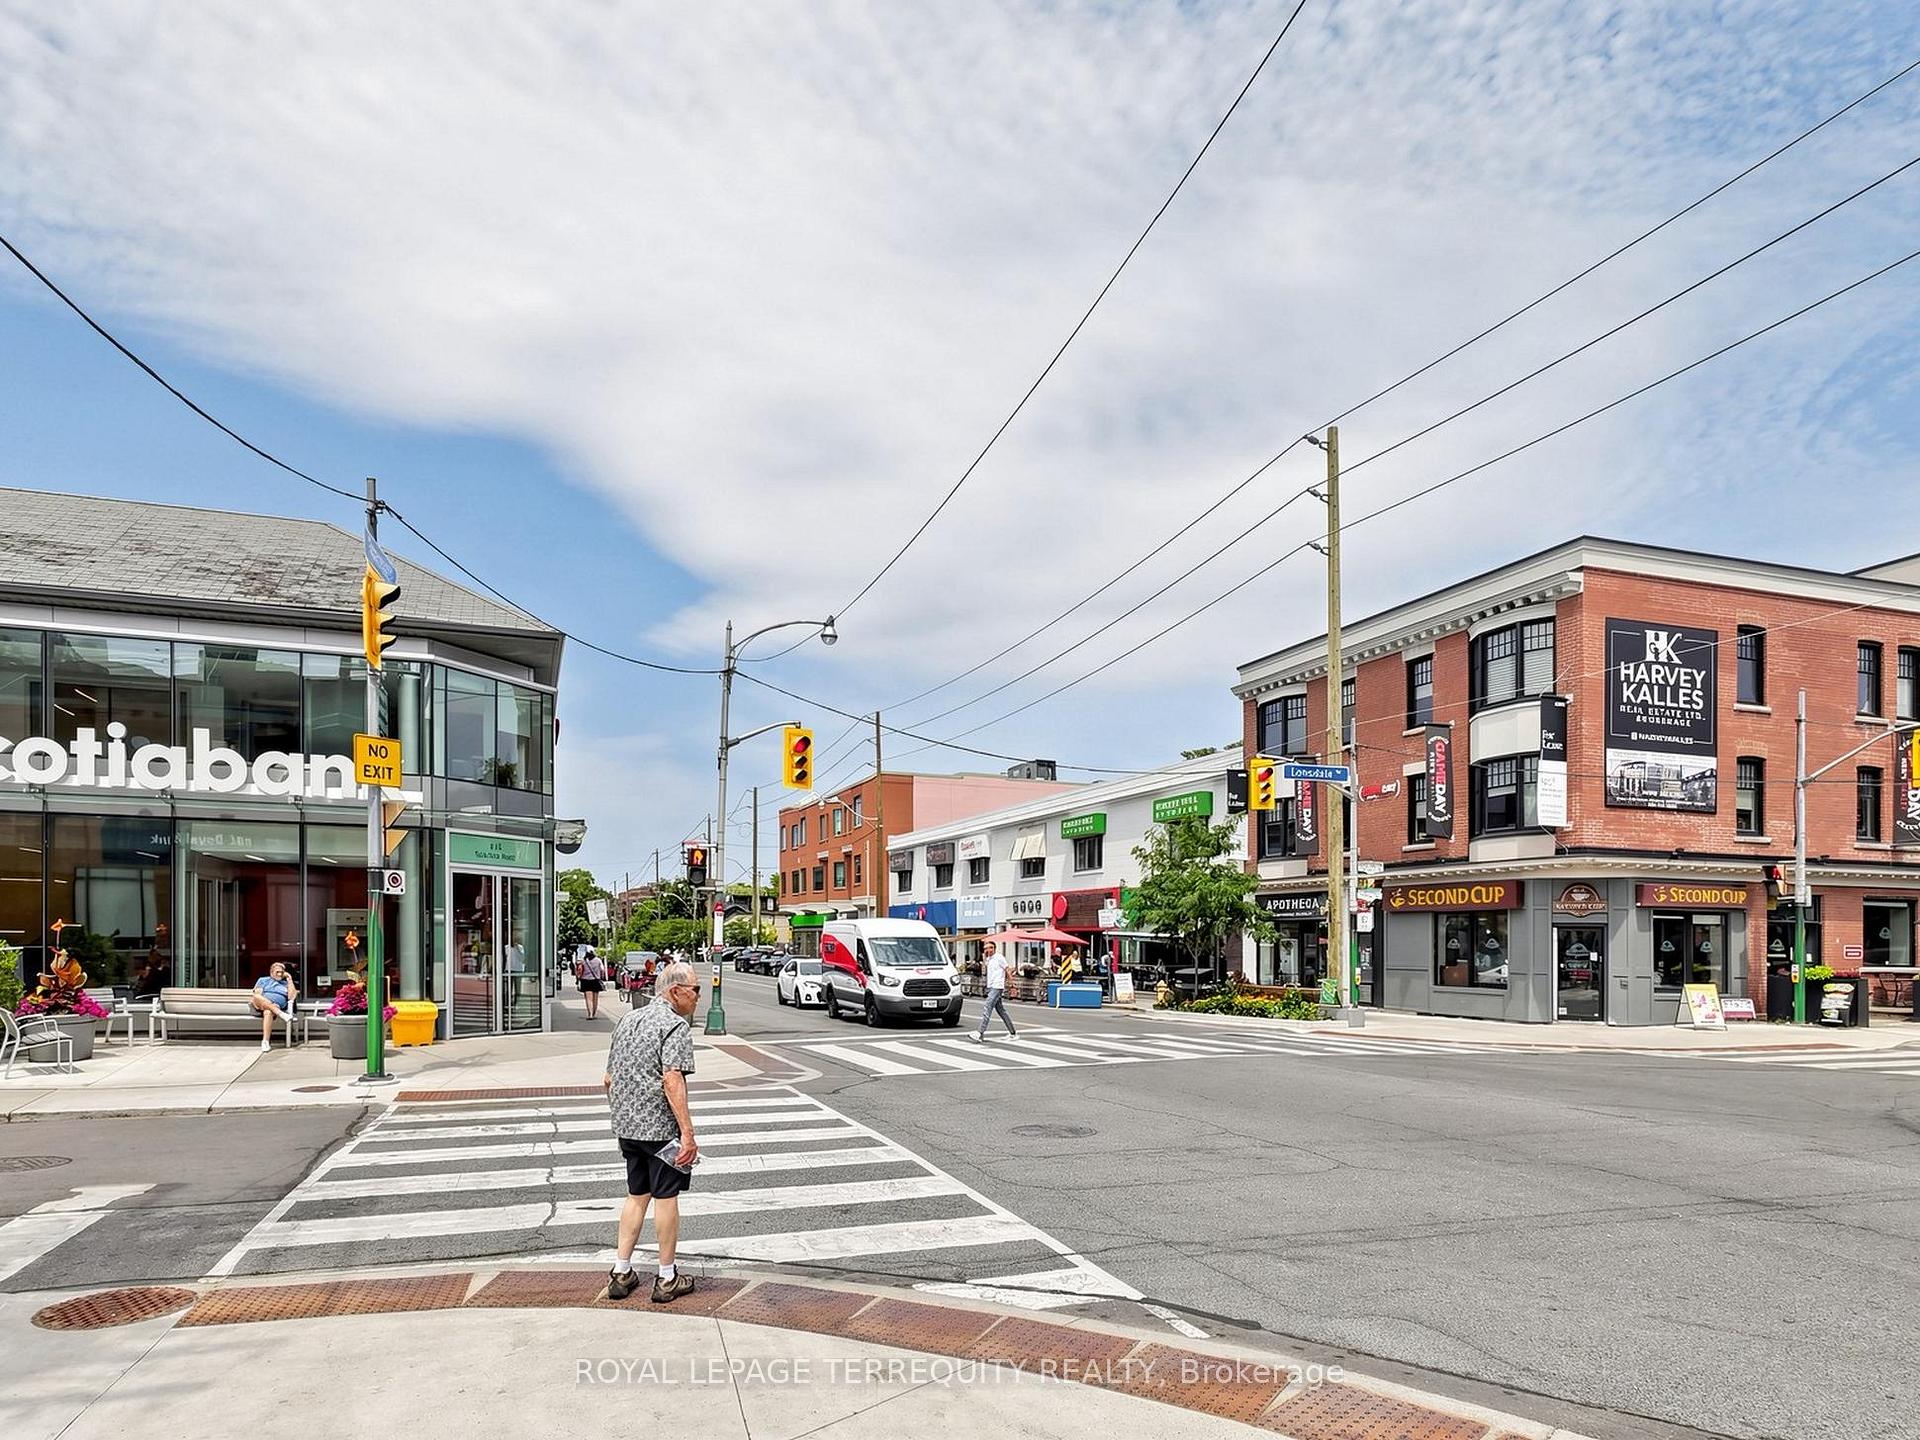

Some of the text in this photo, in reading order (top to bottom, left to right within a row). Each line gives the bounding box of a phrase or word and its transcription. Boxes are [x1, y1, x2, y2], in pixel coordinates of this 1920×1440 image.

[1620, 661, 1706, 689] HARVEY
[1623, 682, 1704, 710] KALLES
[368, 743, 388, 759] NO
[363, 764, 393, 780] EXIT
[1408, 886, 1505, 906] SECOND CUP
[1669, 887, 1747, 904] SECOND CUP
